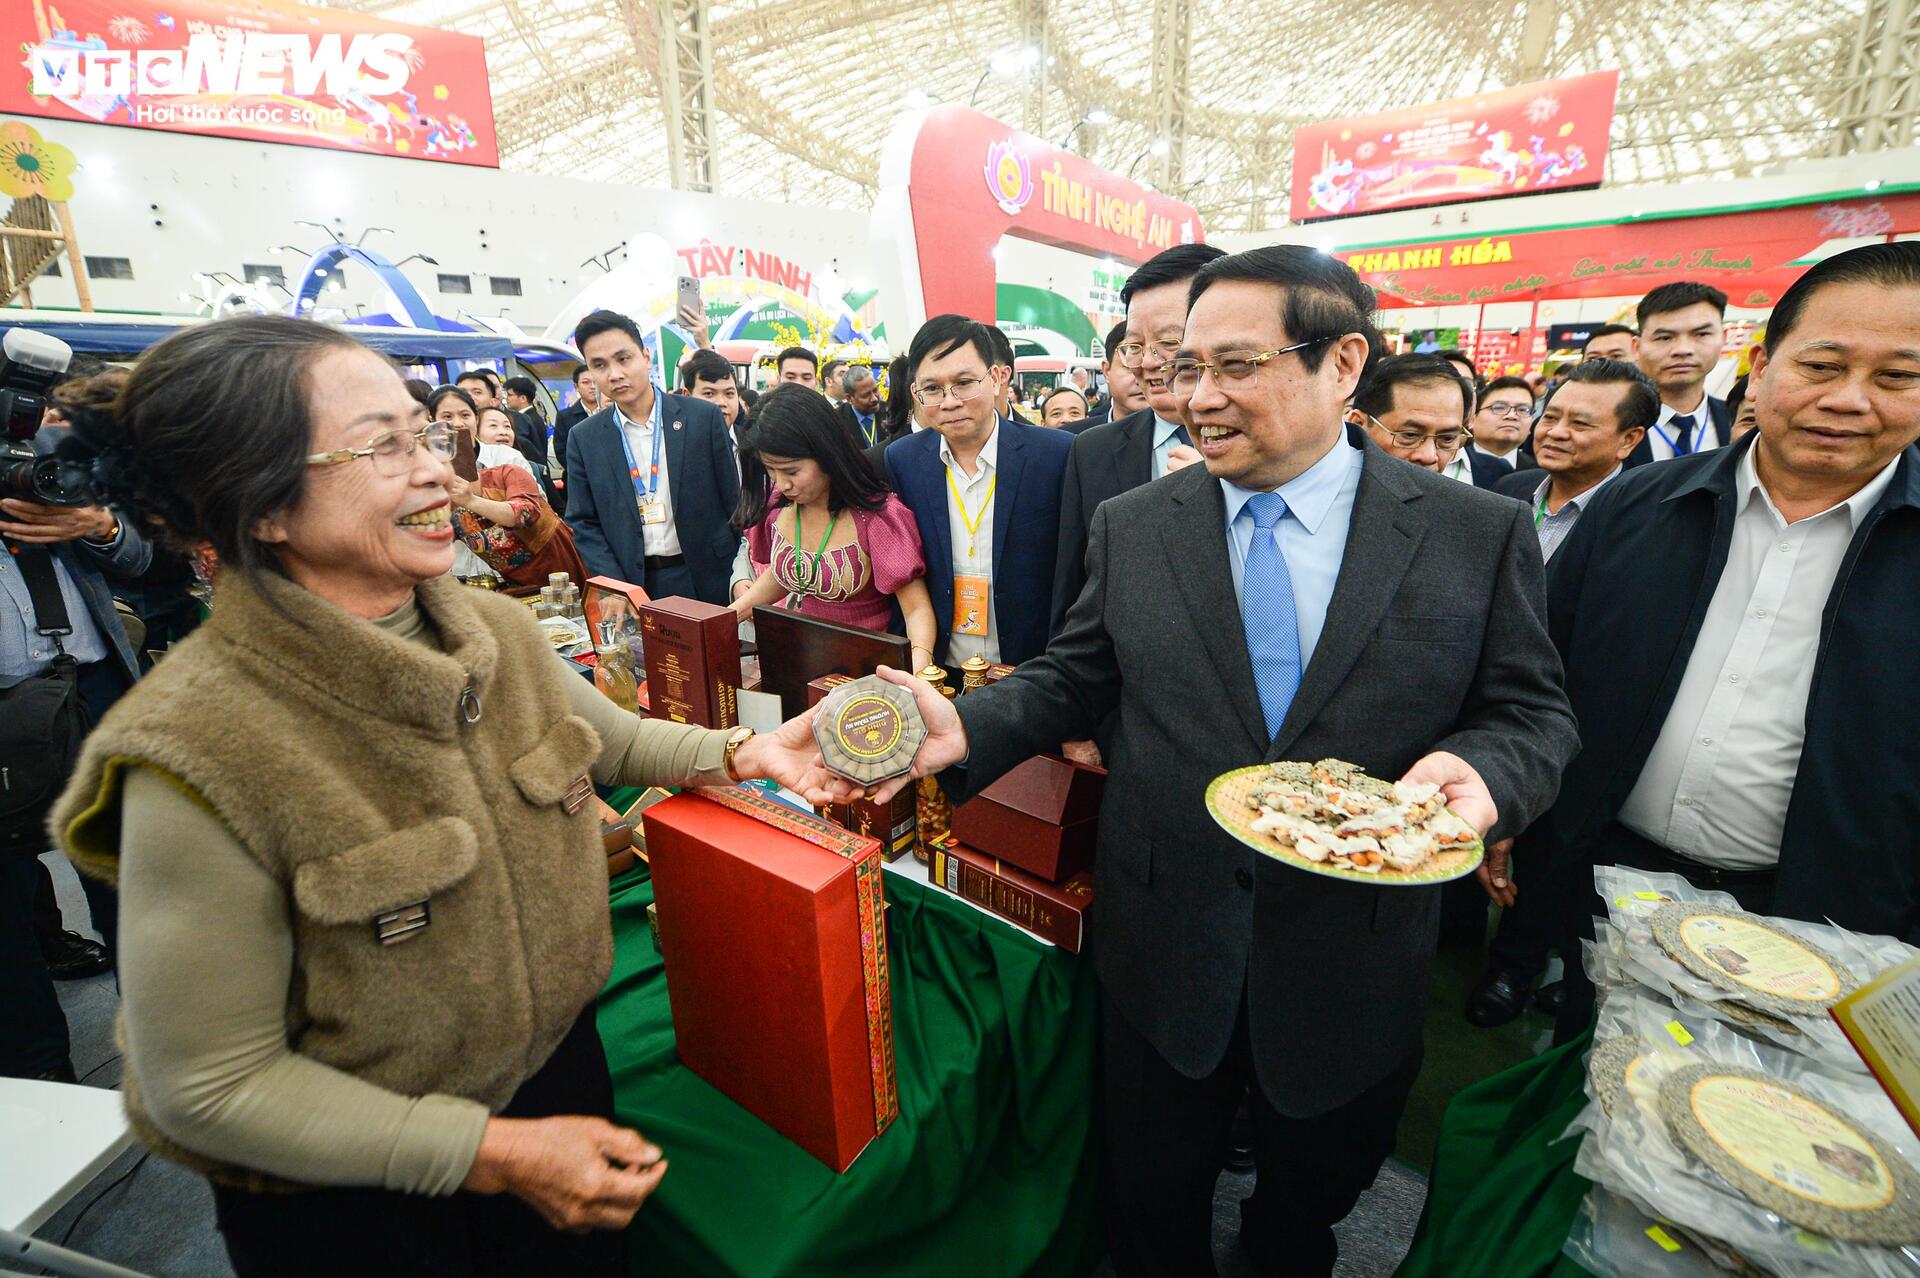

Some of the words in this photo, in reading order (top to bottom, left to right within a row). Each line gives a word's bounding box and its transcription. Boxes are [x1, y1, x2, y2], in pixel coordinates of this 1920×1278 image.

[1041, 162, 1092, 224] TỈNH
[1096, 192, 1146, 249] NGHỆ
[1148, 214, 1172, 248] AN
[676, 238, 735, 278] TÂY
[745, 250, 812, 297] NINH
[1348, 248, 1443, 273] THANH
[1450, 237, 1513, 266] HÓA
[1686, 248, 1753, 271] Thanh
[10, 448, 34, 457] Canon
